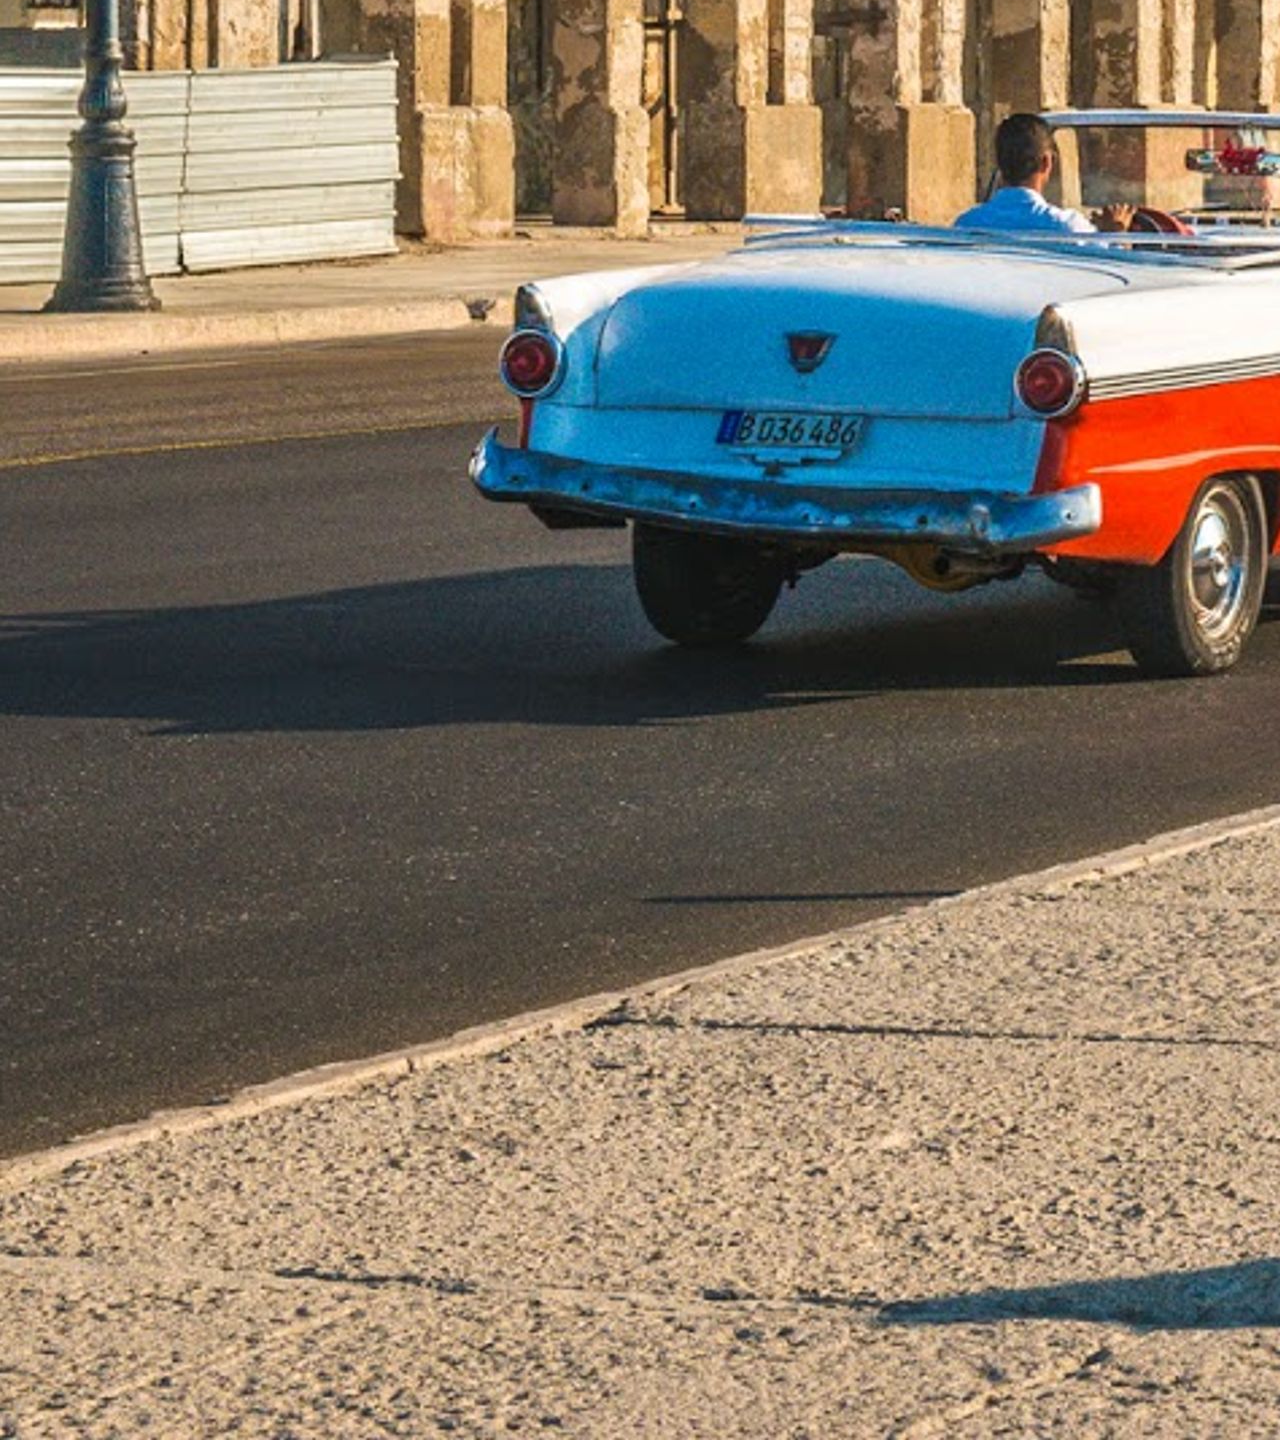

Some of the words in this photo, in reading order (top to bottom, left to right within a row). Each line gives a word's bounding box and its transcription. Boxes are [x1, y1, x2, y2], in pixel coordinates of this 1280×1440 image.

[737, 414, 755, 441] B
[757, 417, 805, 443] 036
[808, 417, 859, 445] 486
